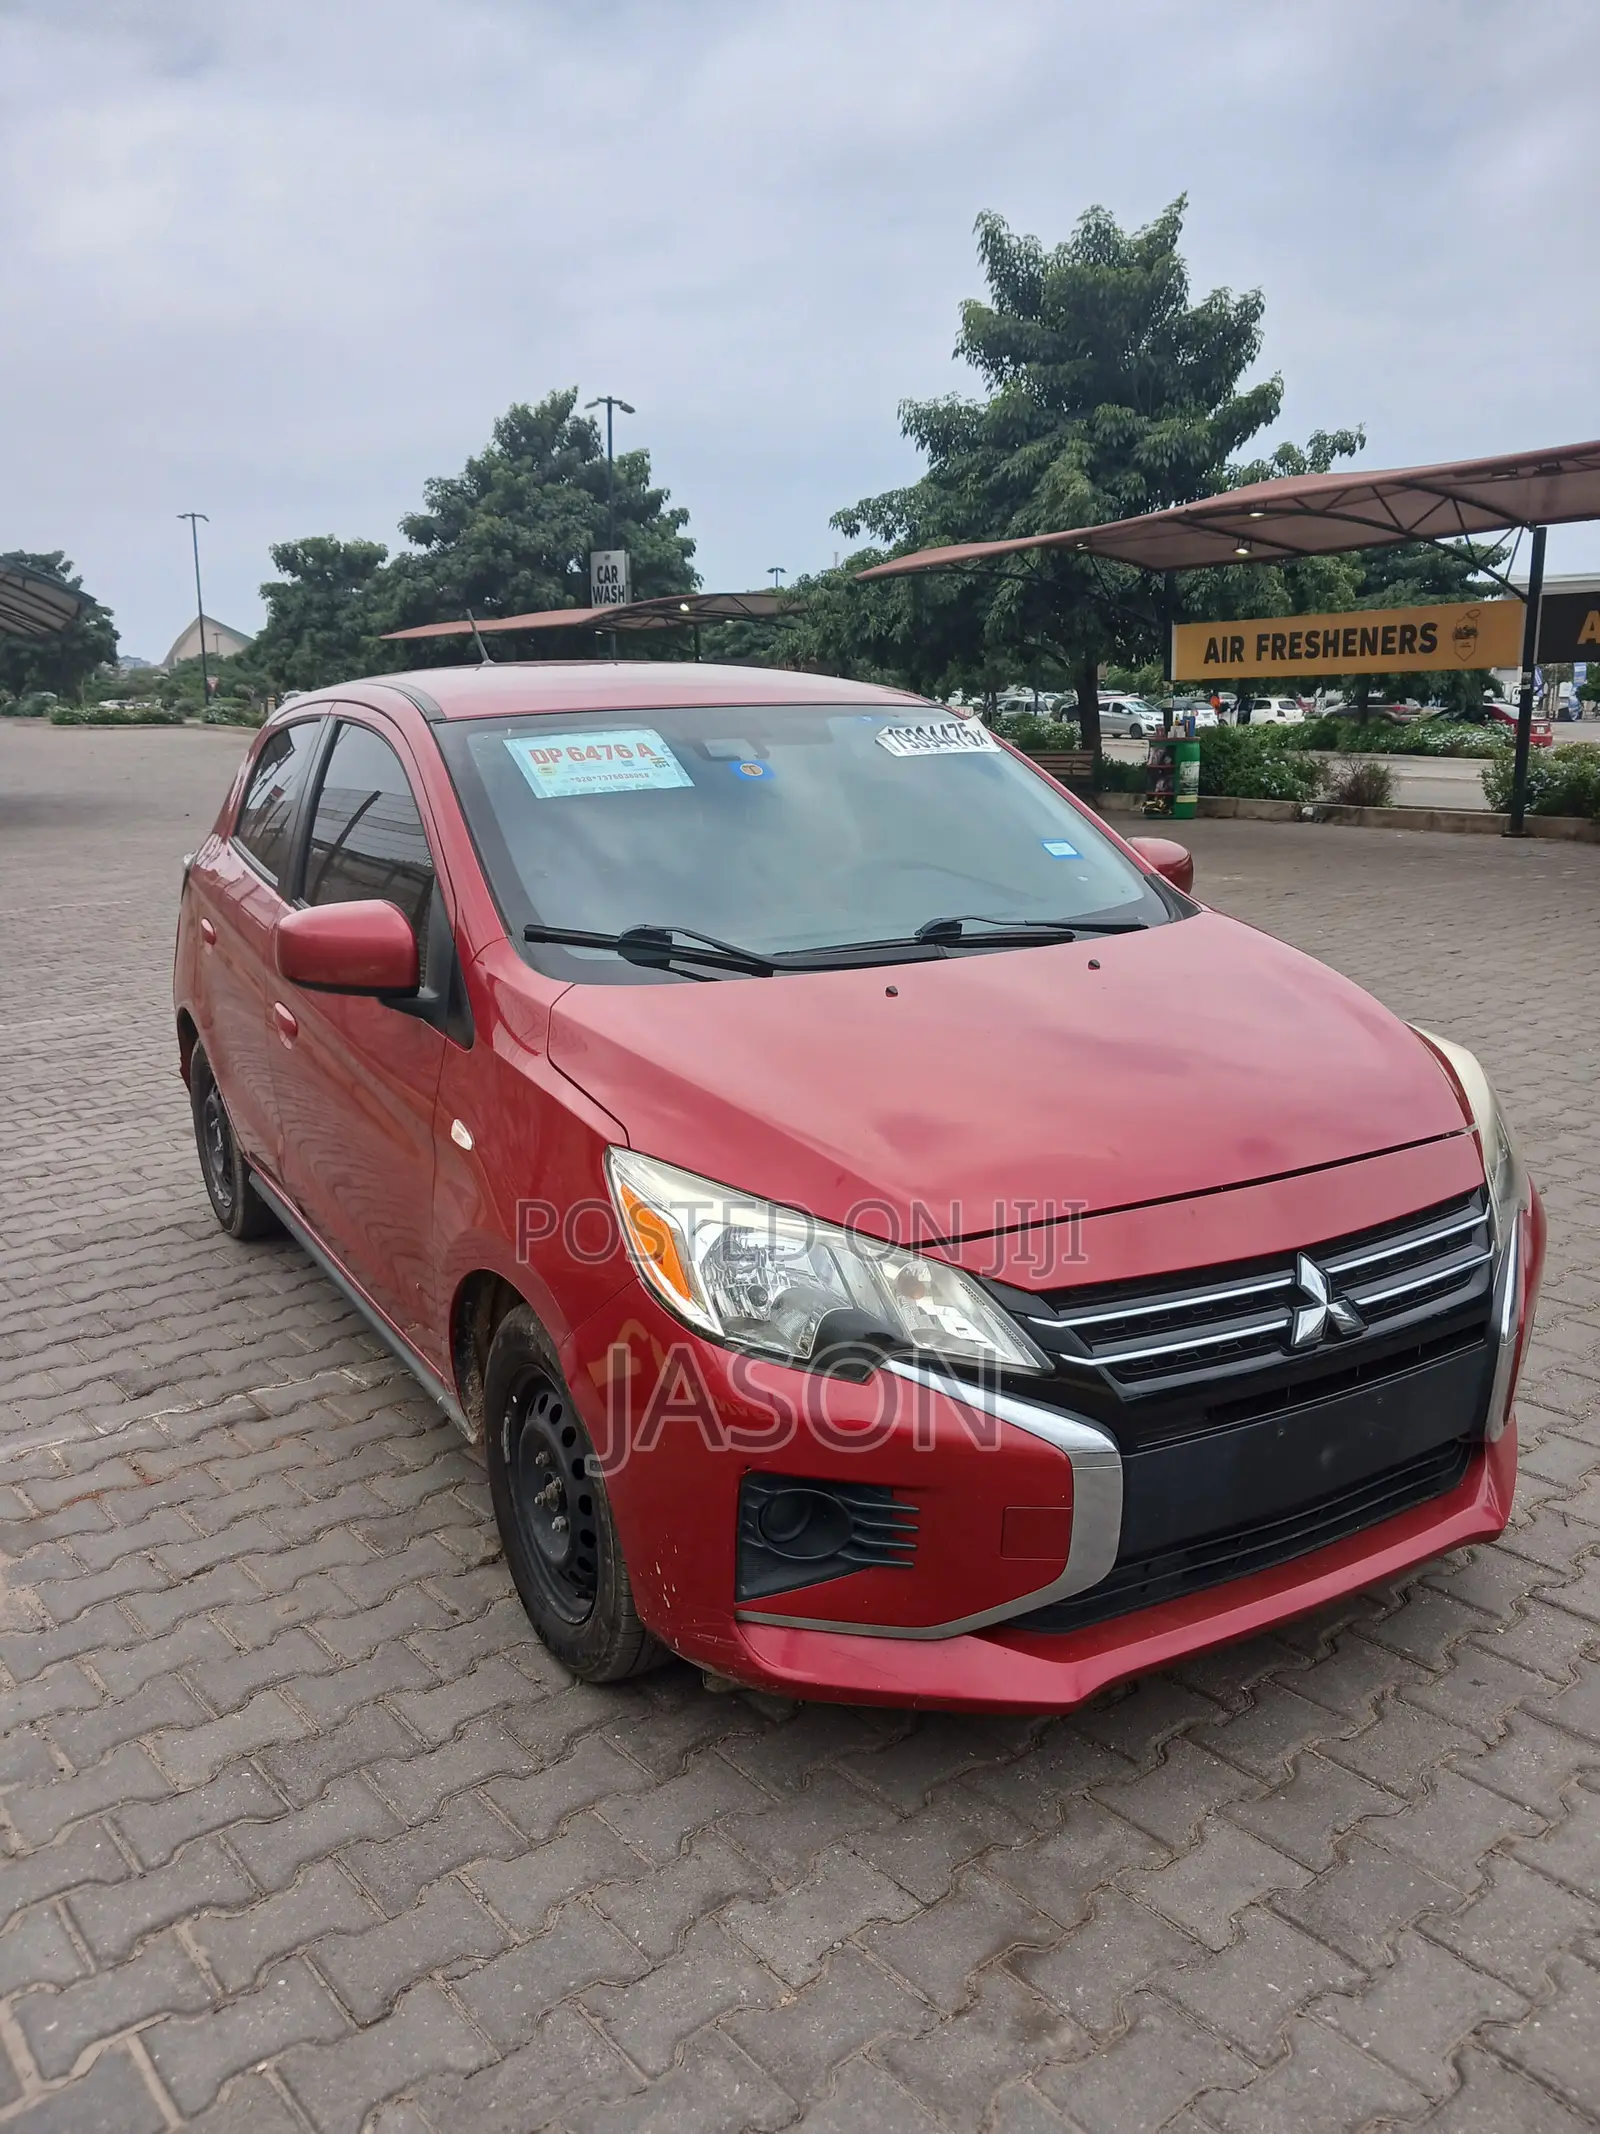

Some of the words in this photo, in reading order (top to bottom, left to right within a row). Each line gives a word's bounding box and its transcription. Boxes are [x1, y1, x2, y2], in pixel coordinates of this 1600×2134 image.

[597, 565, 619, 584] CAR
[592, 585, 625, 604] WASH
[1203, 635, 1245, 664] AIR
[1256, 622, 1439, 662] FRESHENERS
[529, 748, 563, 765] DP
[566, 744, 633, 762] 6476
[636, 742, 657, 758] A
